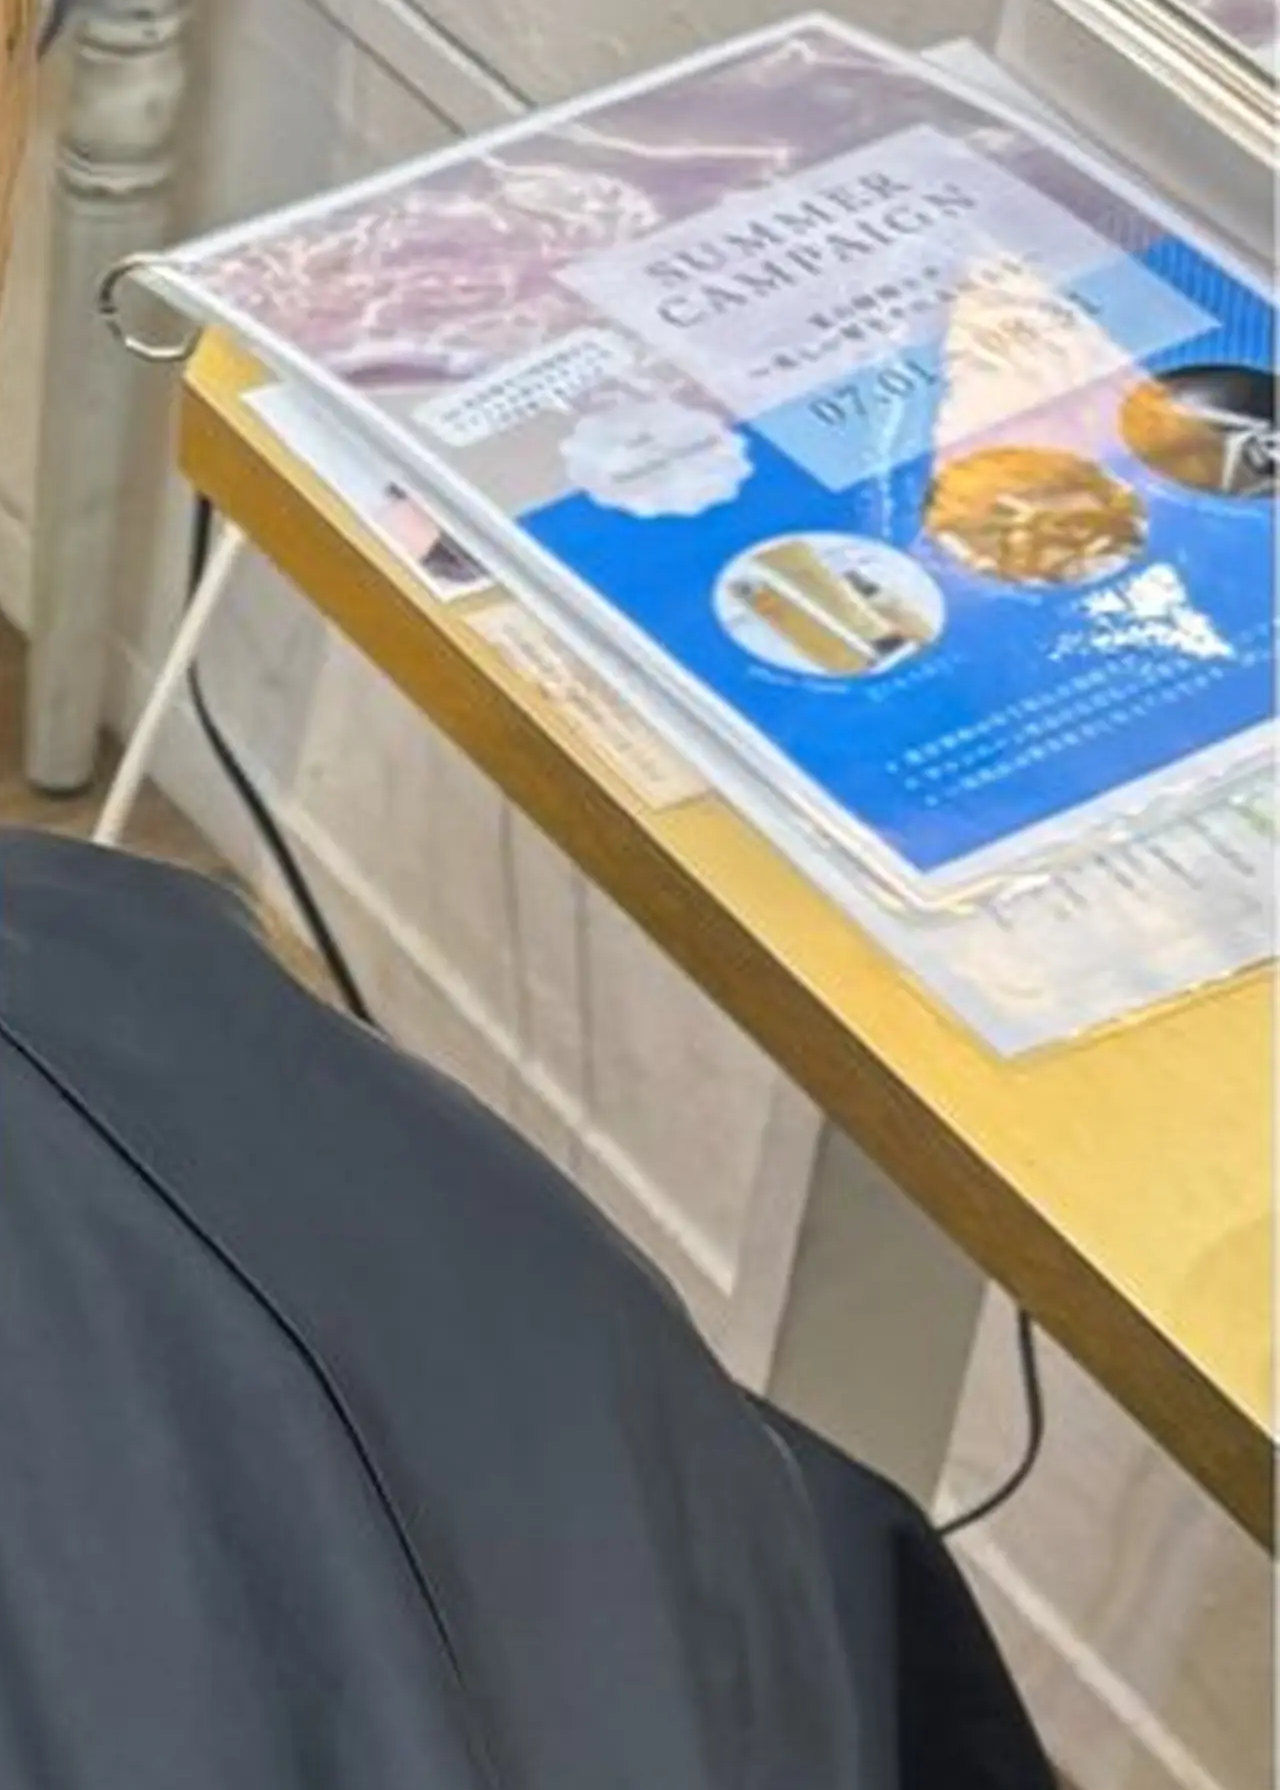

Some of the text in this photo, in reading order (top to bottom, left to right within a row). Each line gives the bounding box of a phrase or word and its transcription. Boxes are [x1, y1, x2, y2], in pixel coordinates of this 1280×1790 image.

[644, 172, 911, 288] SUMMER
[657, 182, 977, 329] CAMPAIGN
[808, 358, 939, 427] 07.01
